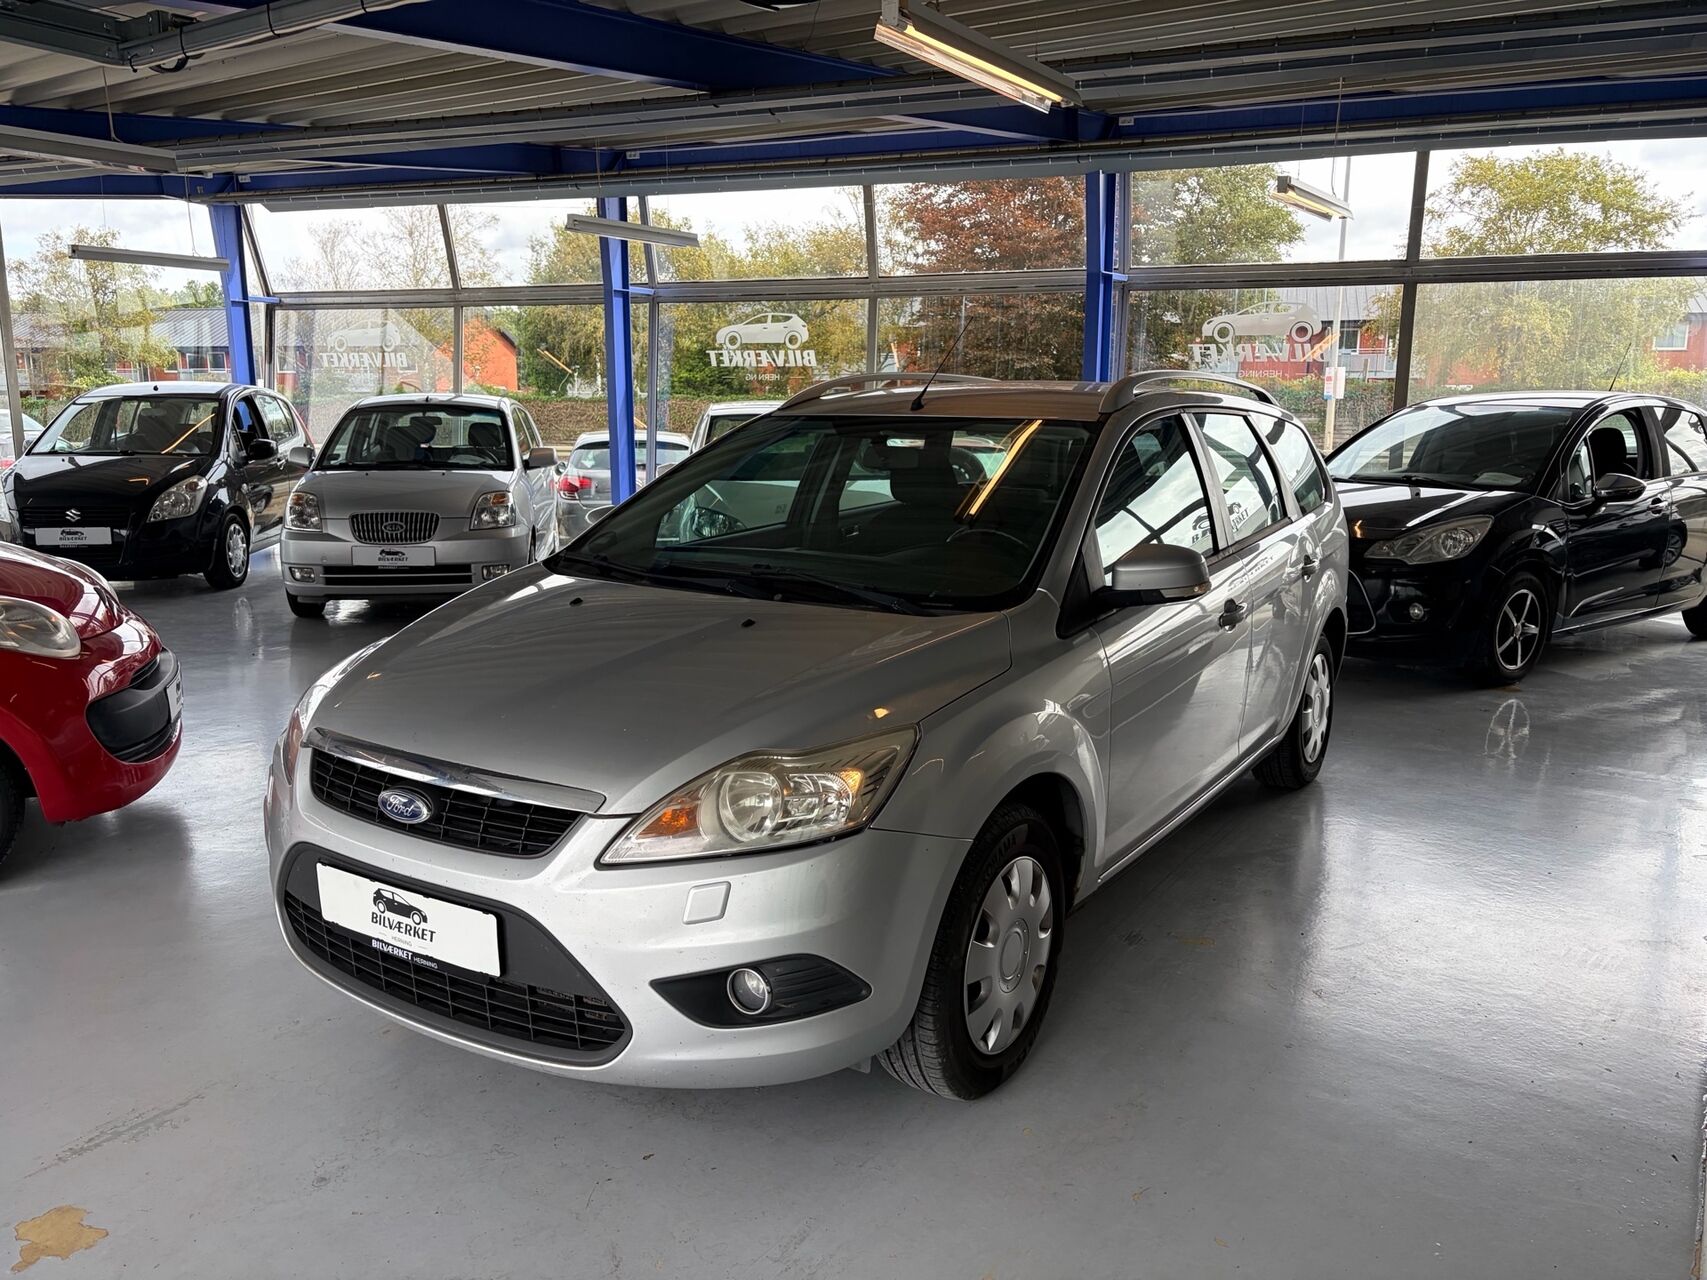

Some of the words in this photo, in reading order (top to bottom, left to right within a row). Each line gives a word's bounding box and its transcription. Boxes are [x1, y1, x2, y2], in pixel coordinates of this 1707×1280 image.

[386, 794, 414, 816] Ford
[371, 912, 437, 943] BILVÆRKET
[391, 935, 413, 947] HERNING
[371, 939, 413, 961] BILVÆRKET
[413, 956, 439, 970] HERNING
